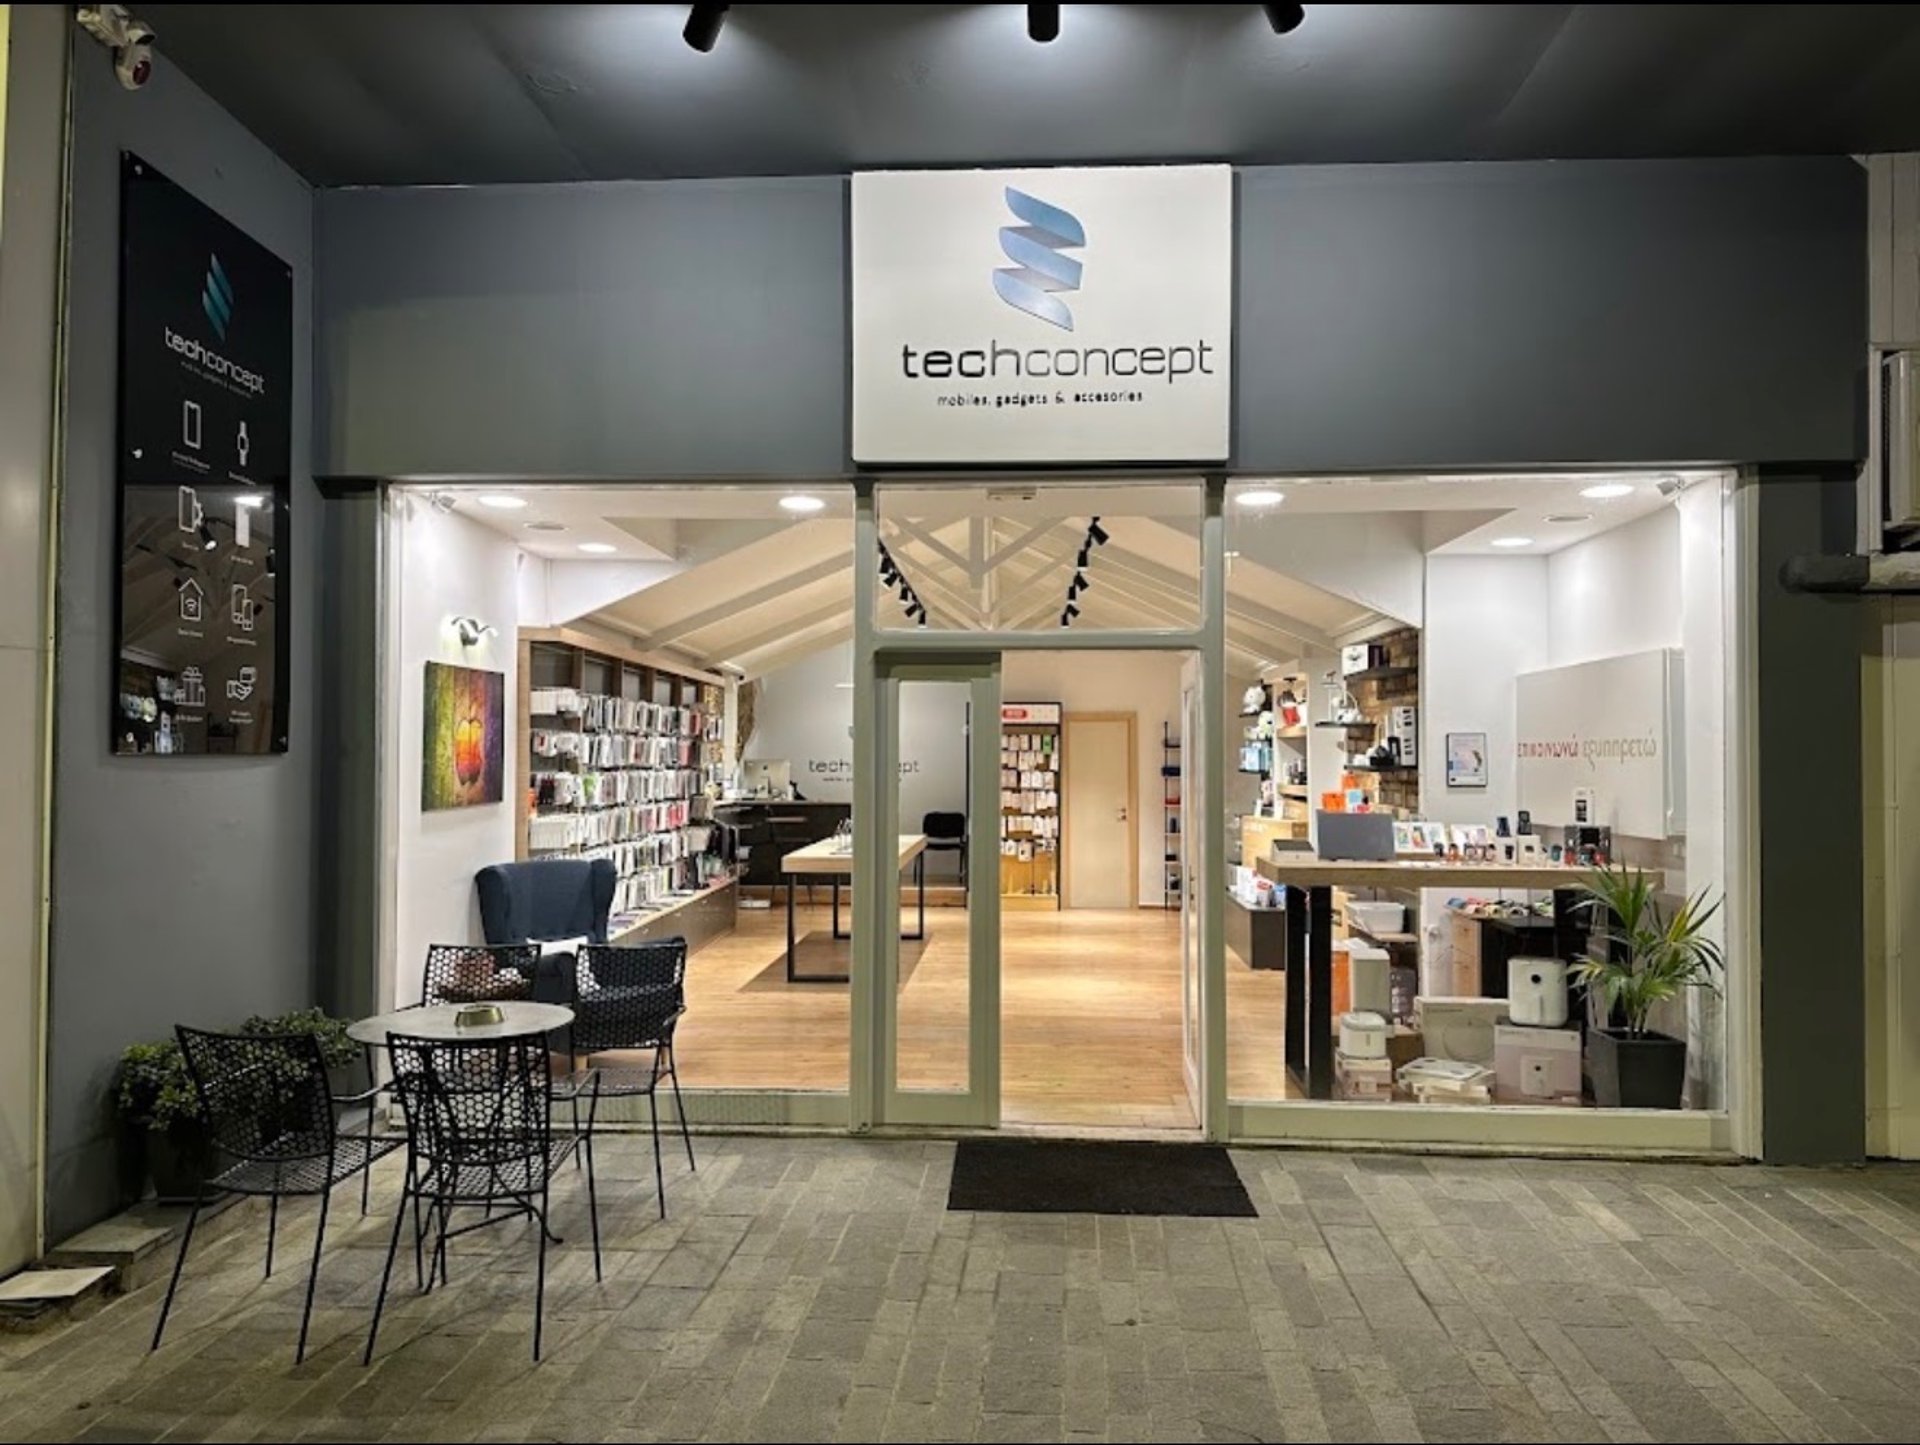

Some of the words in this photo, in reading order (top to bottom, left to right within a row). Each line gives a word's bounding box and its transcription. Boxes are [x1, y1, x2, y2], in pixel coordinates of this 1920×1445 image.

[165, 326, 265, 394] techconcept
[902, 339, 1214, 384] techconcept
[996, 392, 1049, 408] gadgets
[1055, 390, 1066, 404] &
[1074, 390, 1143, 403] accesories
